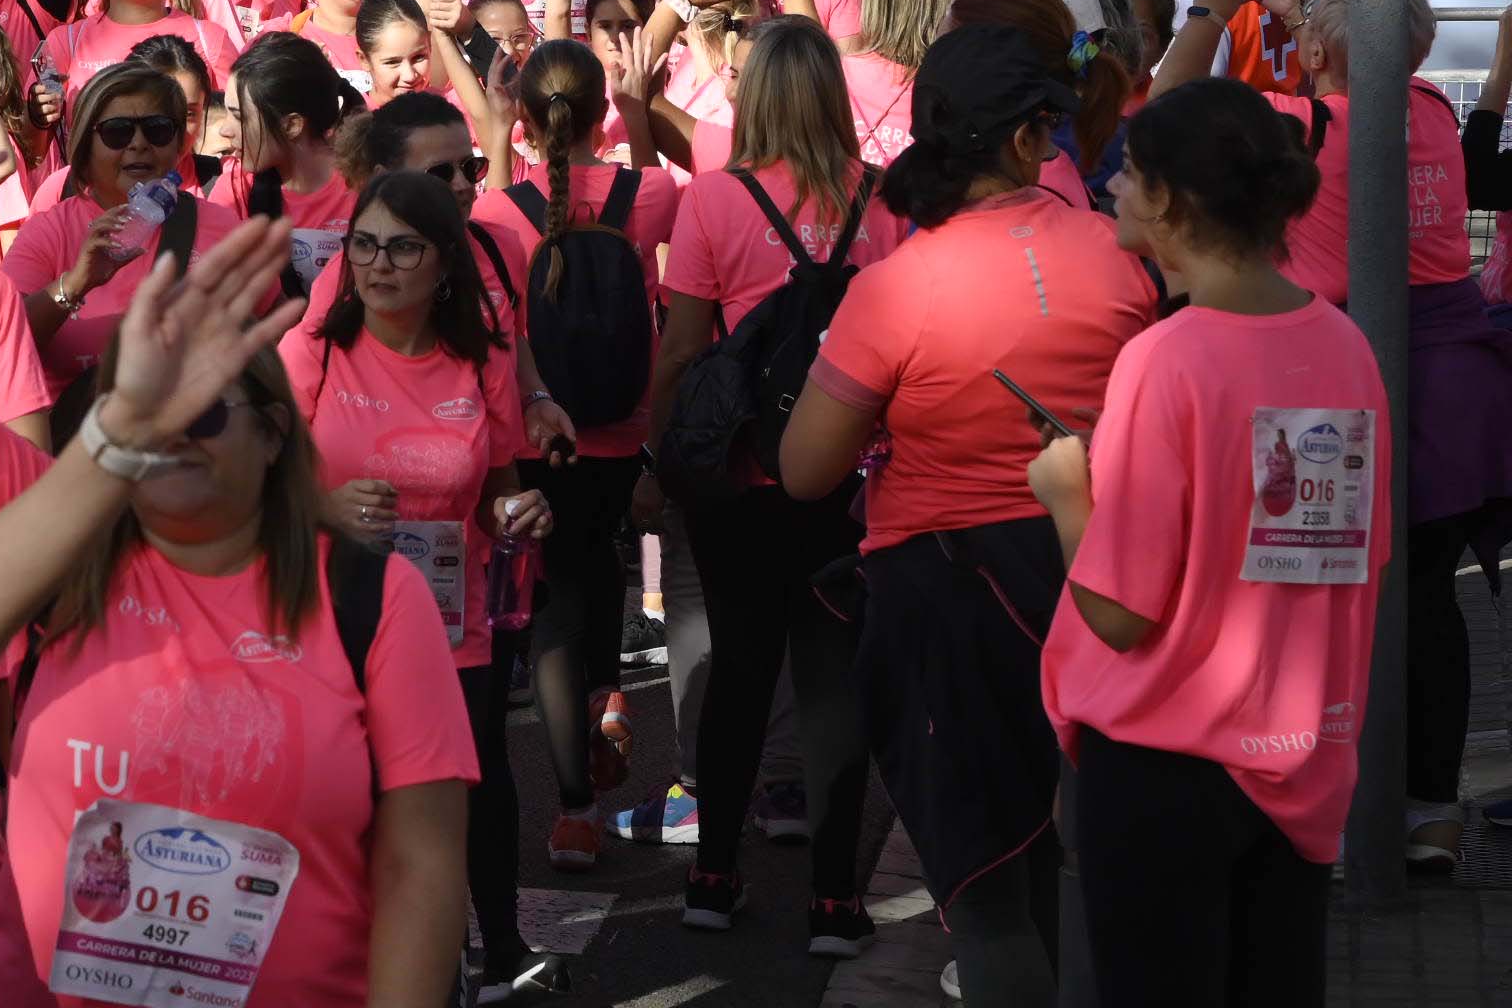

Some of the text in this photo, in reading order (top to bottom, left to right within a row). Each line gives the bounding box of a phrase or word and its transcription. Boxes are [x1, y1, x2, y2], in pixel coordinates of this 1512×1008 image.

[1300, 478, 1335, 503] 016
[1257, 555, 1303, 570] OYSHO
[1240, 730, 1317, 756] OYSHO
[67, 738, 130, 795] TU
[140, 838, 224, 870] ASTURIANA
[240, 849, 283, 866] SUMA
[136, 885, 211, 924] 016
[142, 923, 190, 947] 4997
[75, 938, 137, 960] CARRERA
[138, 948, 158, 963] DE
[158, 952, 175, 966] LA
[177, 956, 222, 977] MUJER
[65, 963, 134, 990] OYSHO
